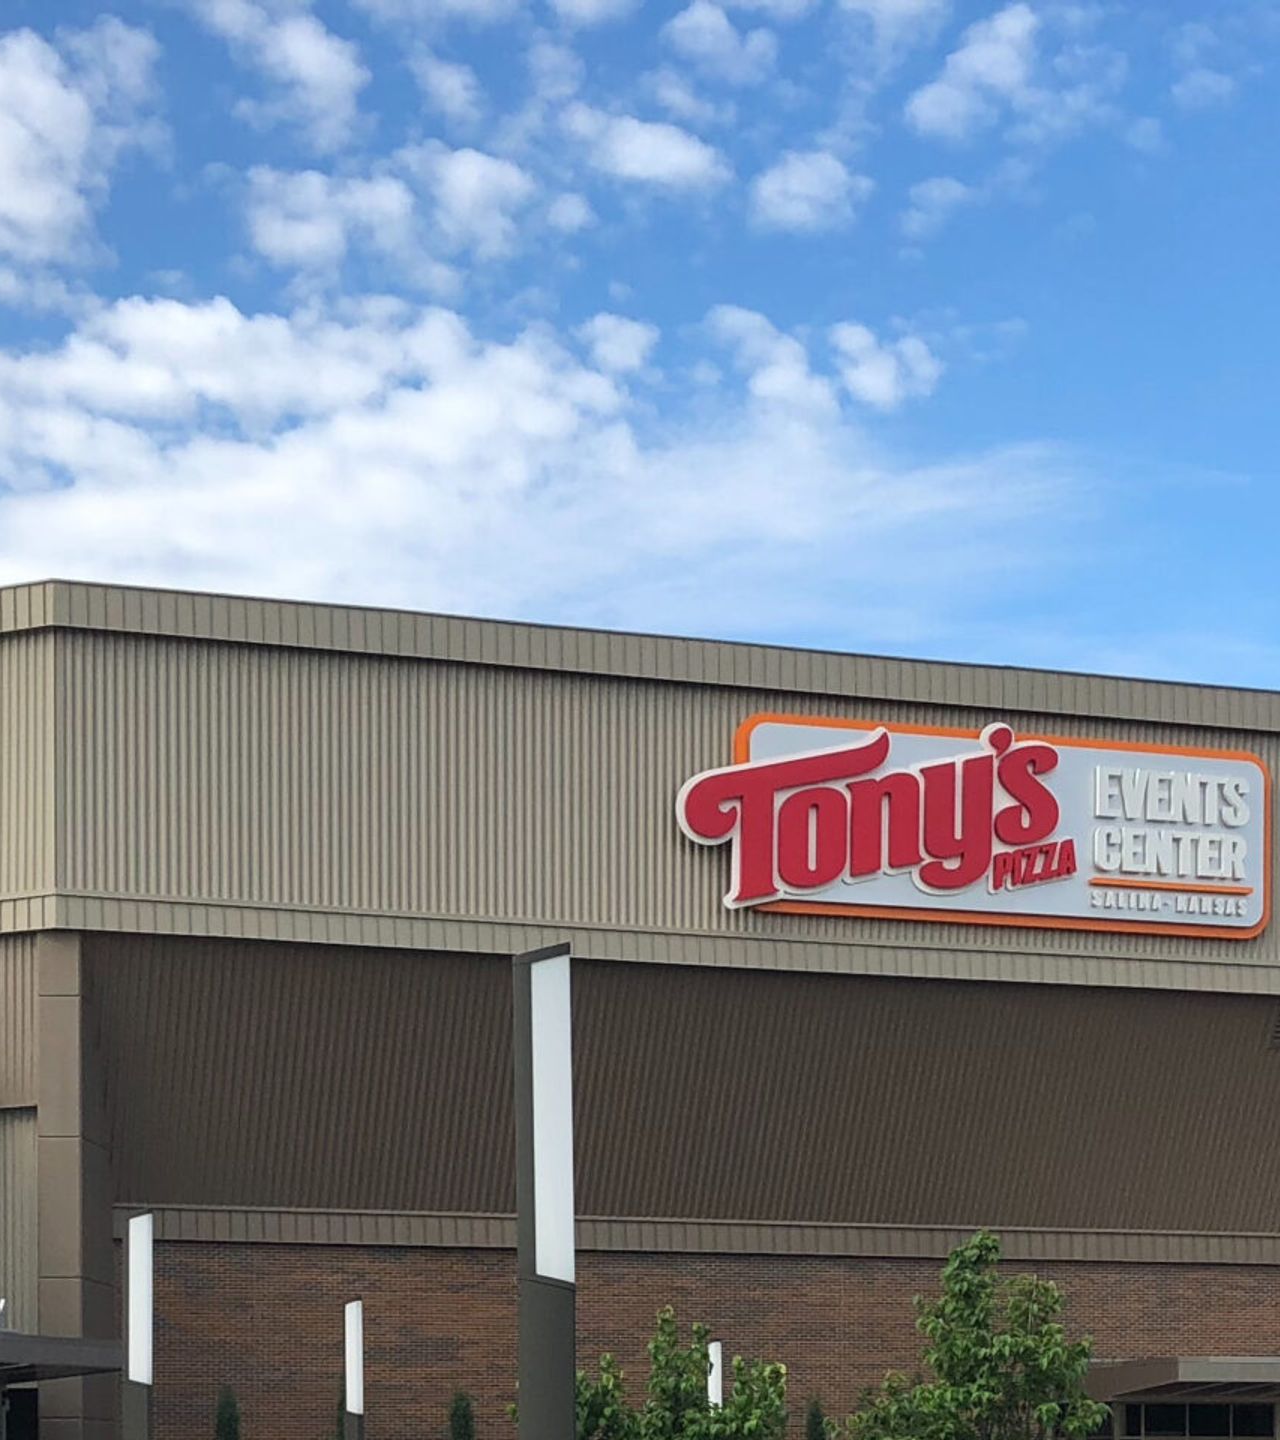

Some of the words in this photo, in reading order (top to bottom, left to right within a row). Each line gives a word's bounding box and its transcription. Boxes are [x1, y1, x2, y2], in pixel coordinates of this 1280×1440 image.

[685, 727, 1059, 901] Tony's
[1095, 765, 1251, 828] EVENTS
[993, 839, 1076, 891] PIZZA
[1094, 825, 1247, 880] CENTER
